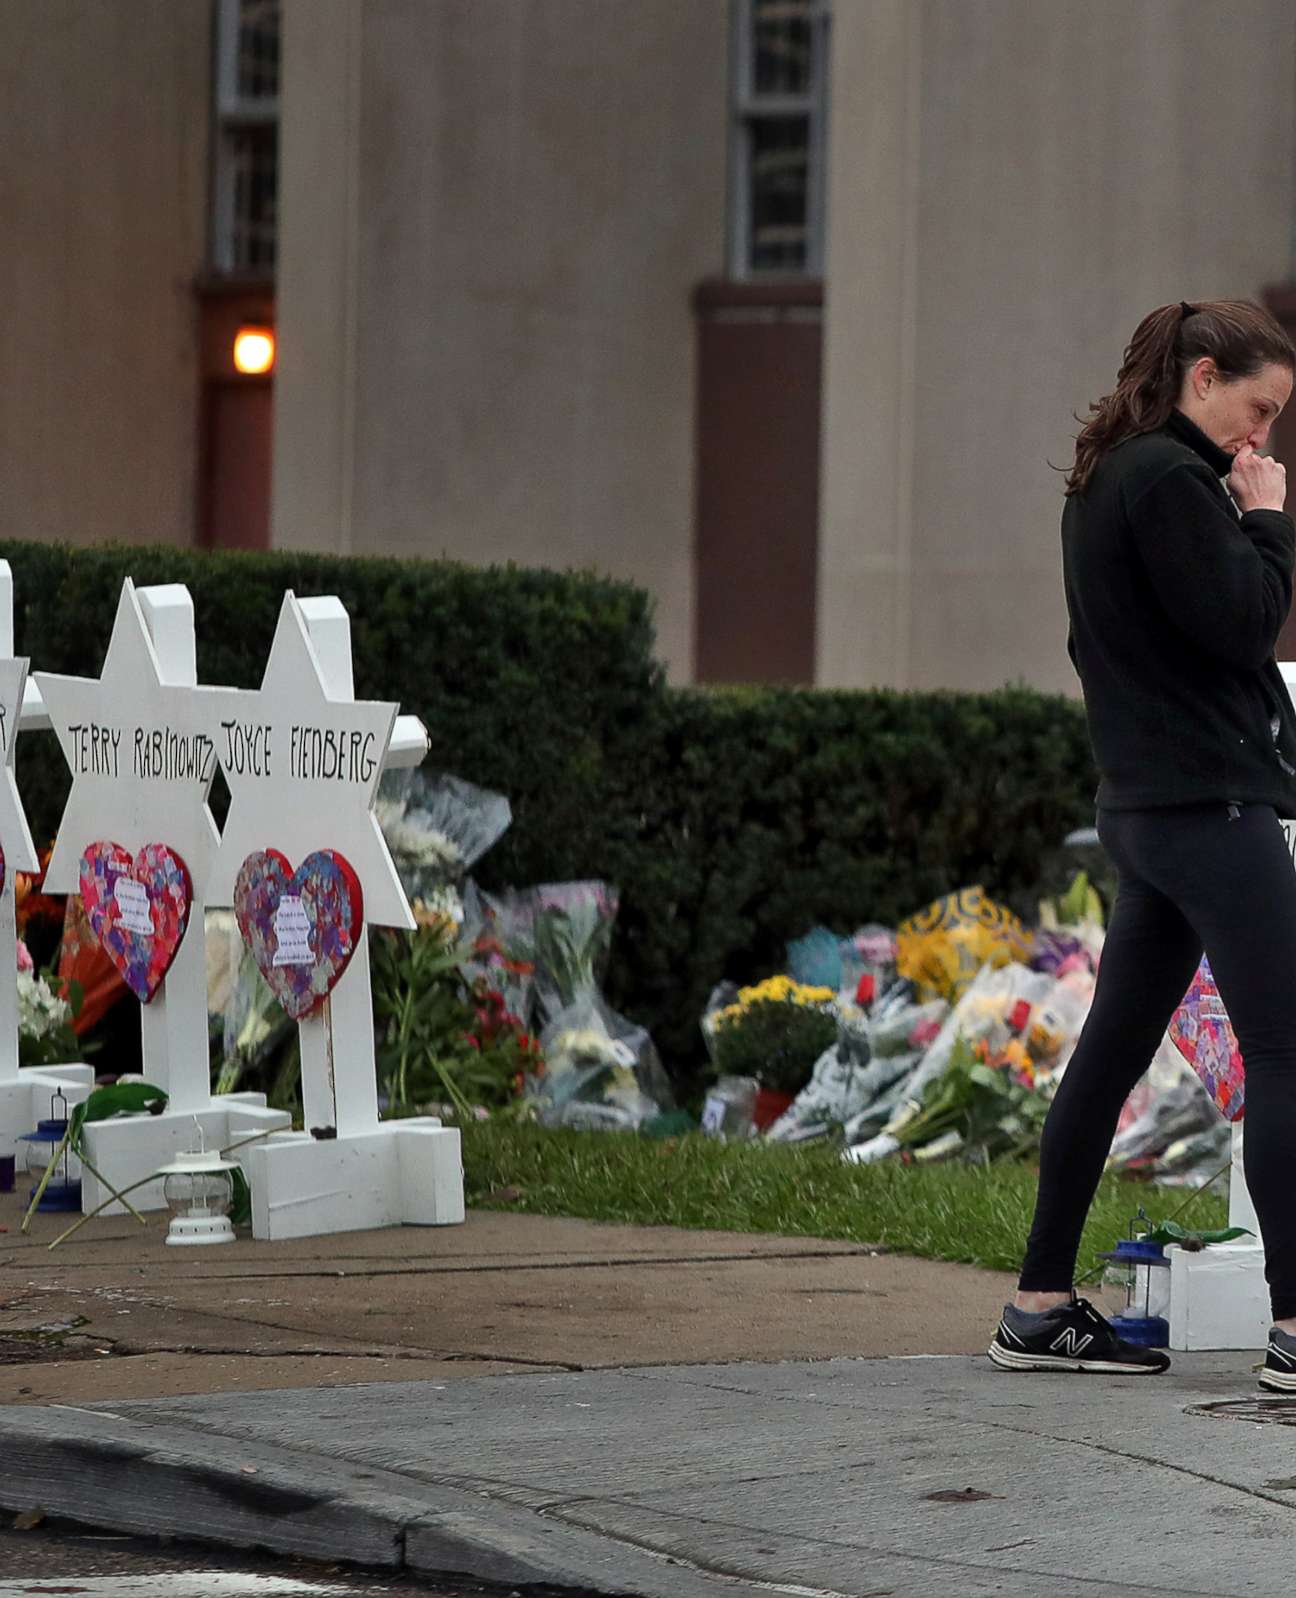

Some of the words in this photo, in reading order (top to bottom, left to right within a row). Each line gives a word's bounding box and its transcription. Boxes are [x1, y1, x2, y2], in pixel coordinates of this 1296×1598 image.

[68, 722, 121, 778] TERRY
[133, 725, 214, 784] RABINOWITZ
[221, 719, 272, 777] JOYCE
[291, 726, 377, 783] FIENBERG
[1049, 1326, 1094, 1357] N
